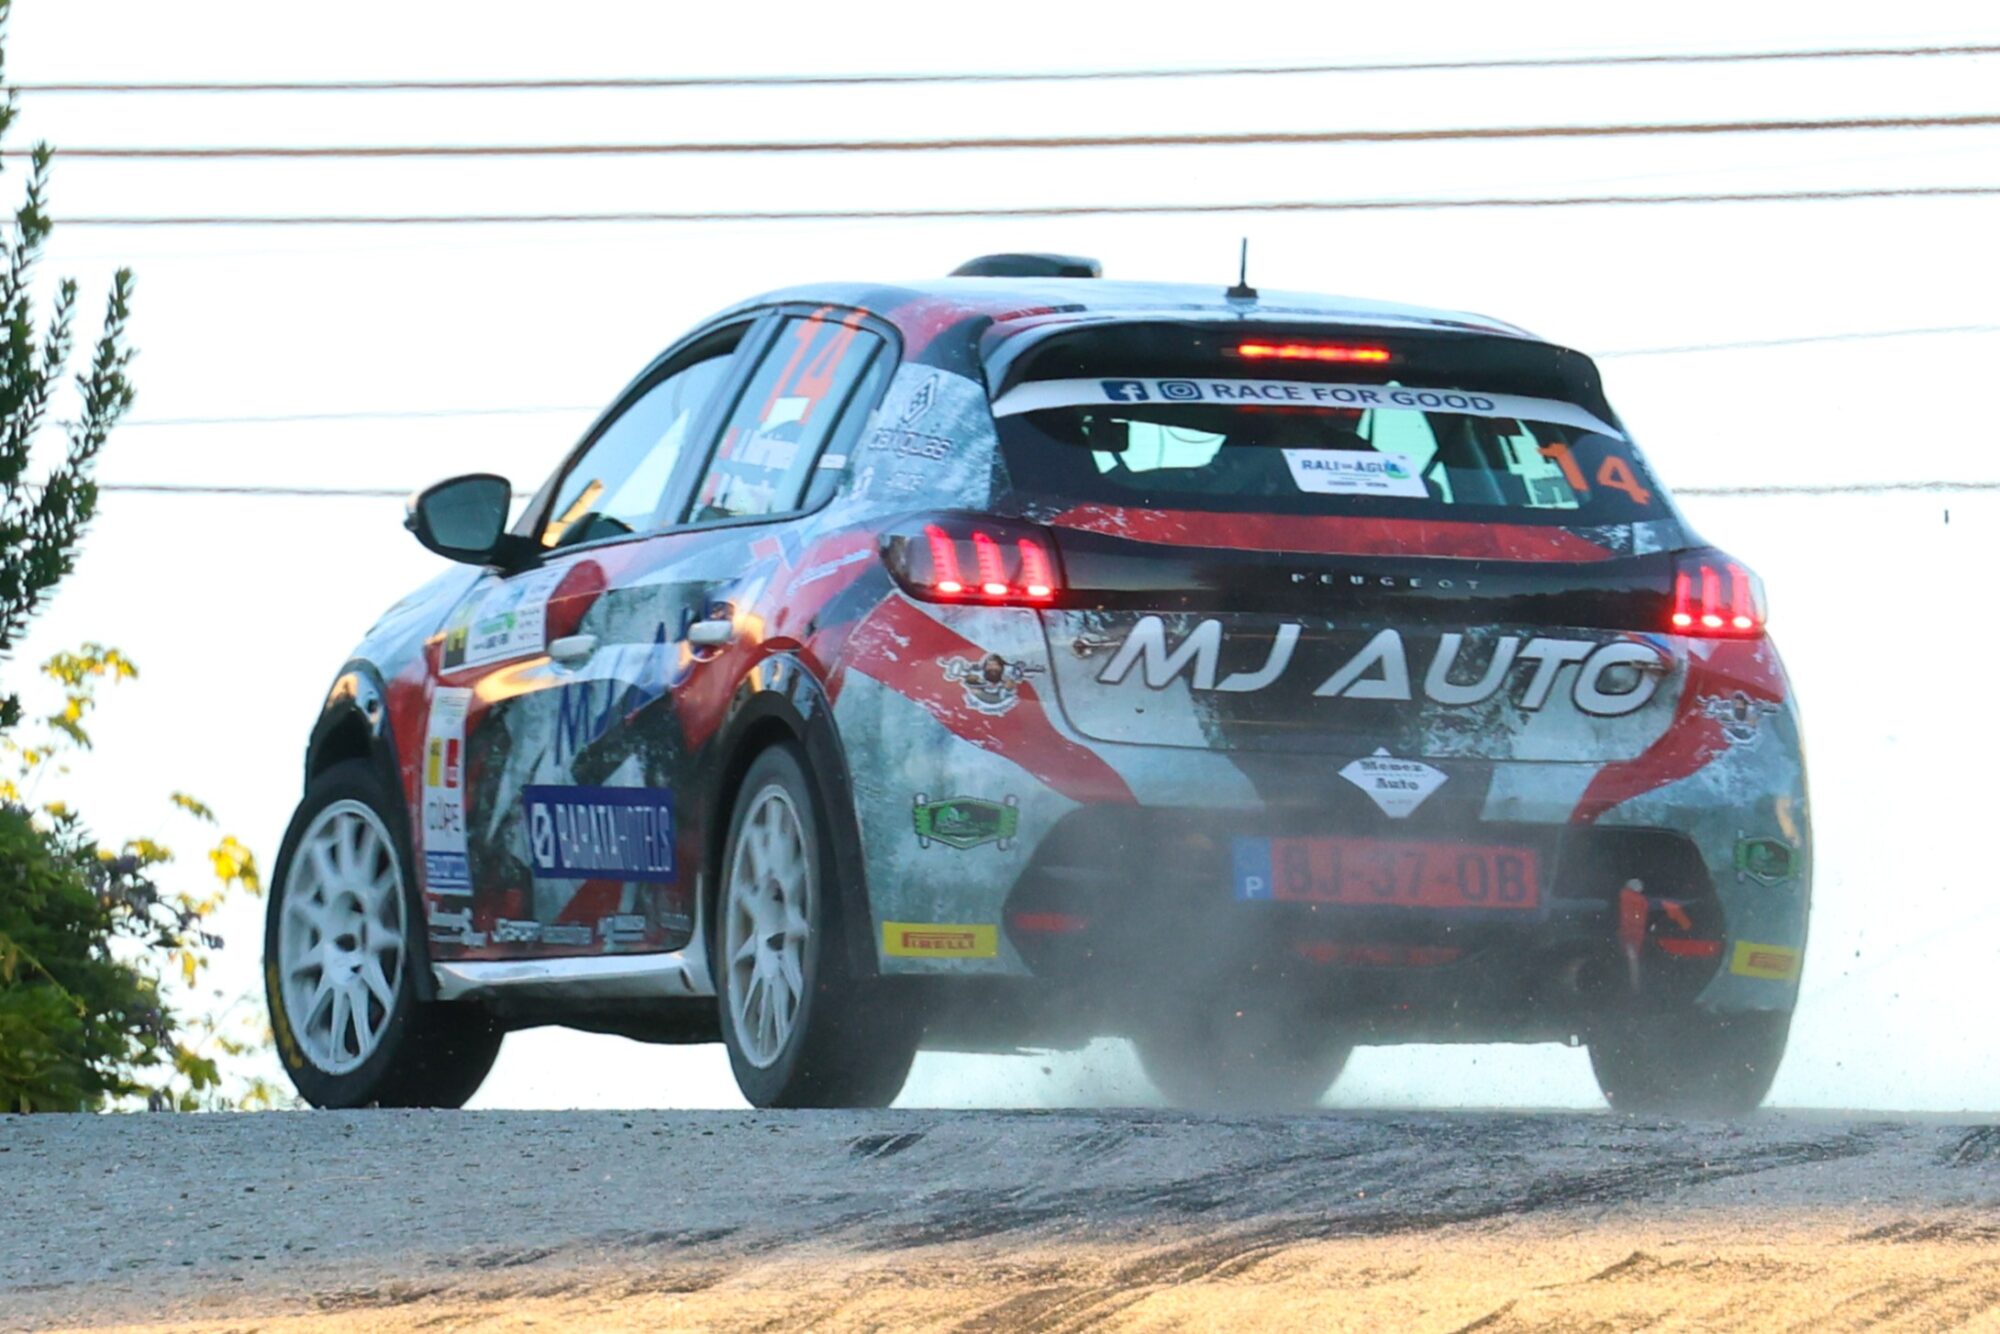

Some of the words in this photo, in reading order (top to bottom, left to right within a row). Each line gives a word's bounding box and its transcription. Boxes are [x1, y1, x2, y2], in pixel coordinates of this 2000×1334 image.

[759, 303, 870, 425] 14
[1211, 383, 1304, 401] RACE
[1311, 388, 1382, 405] FOR
[1390, 390, 1496, 412] GOOD
[1301, 459, 1339, 471] RALI
[1538, 443, 1651, 505] 14
[1291, 573, 1480, 590] PEUGEOT
[1099, 614, 1302, 693] MJ
[1313, 628, 1663, 718] AUTO
[1245, 875, 1264, 898] P
[902, 931, 976, 950] PIRELLI
